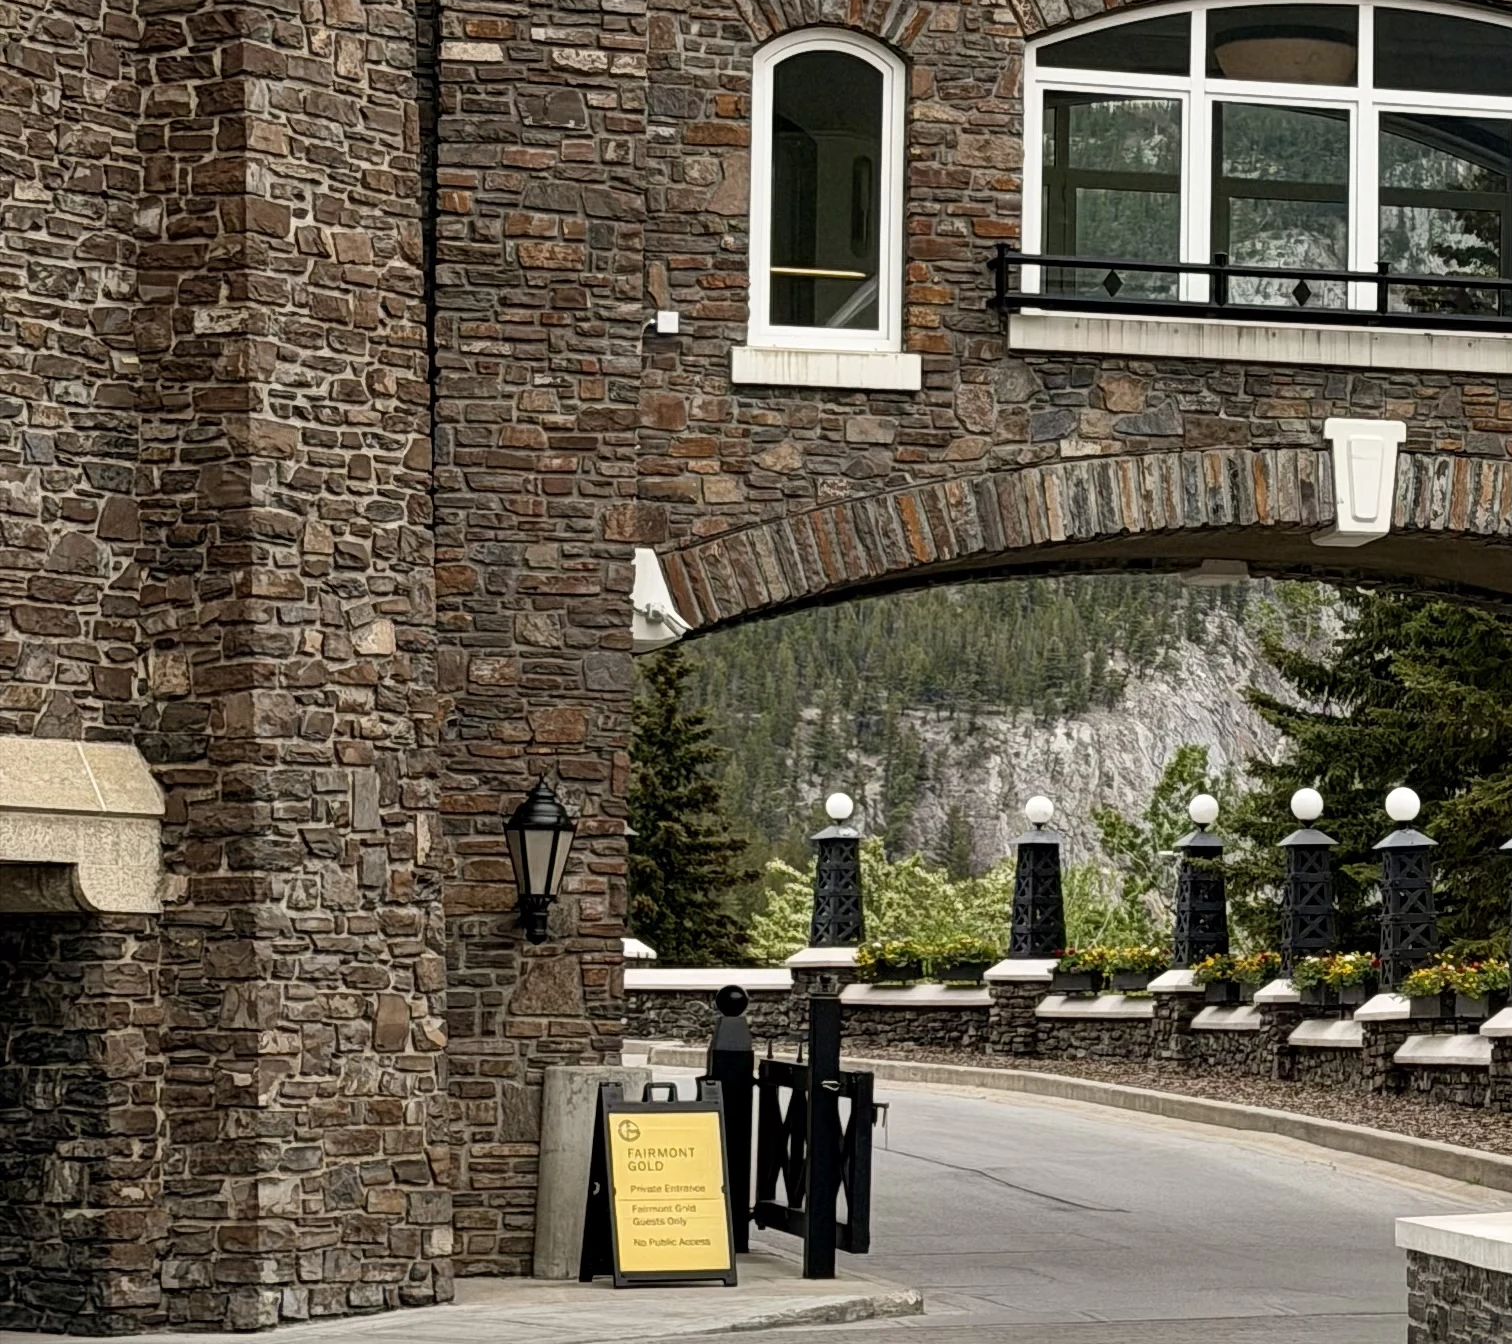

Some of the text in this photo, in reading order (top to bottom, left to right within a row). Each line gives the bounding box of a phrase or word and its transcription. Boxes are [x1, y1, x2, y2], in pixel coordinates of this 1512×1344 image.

[627, 1147, 696, 1159] FAIRMONT
[627, 1160, 665, 1172] GOLD
[630, 1183, 706, 1194] Private Entrance
[631, 1203, 697, 1214] Fairmont Gold
[632, 1216, 688, 1227] Guests Only
[633, 1237, 712, 1247] No Public Access
